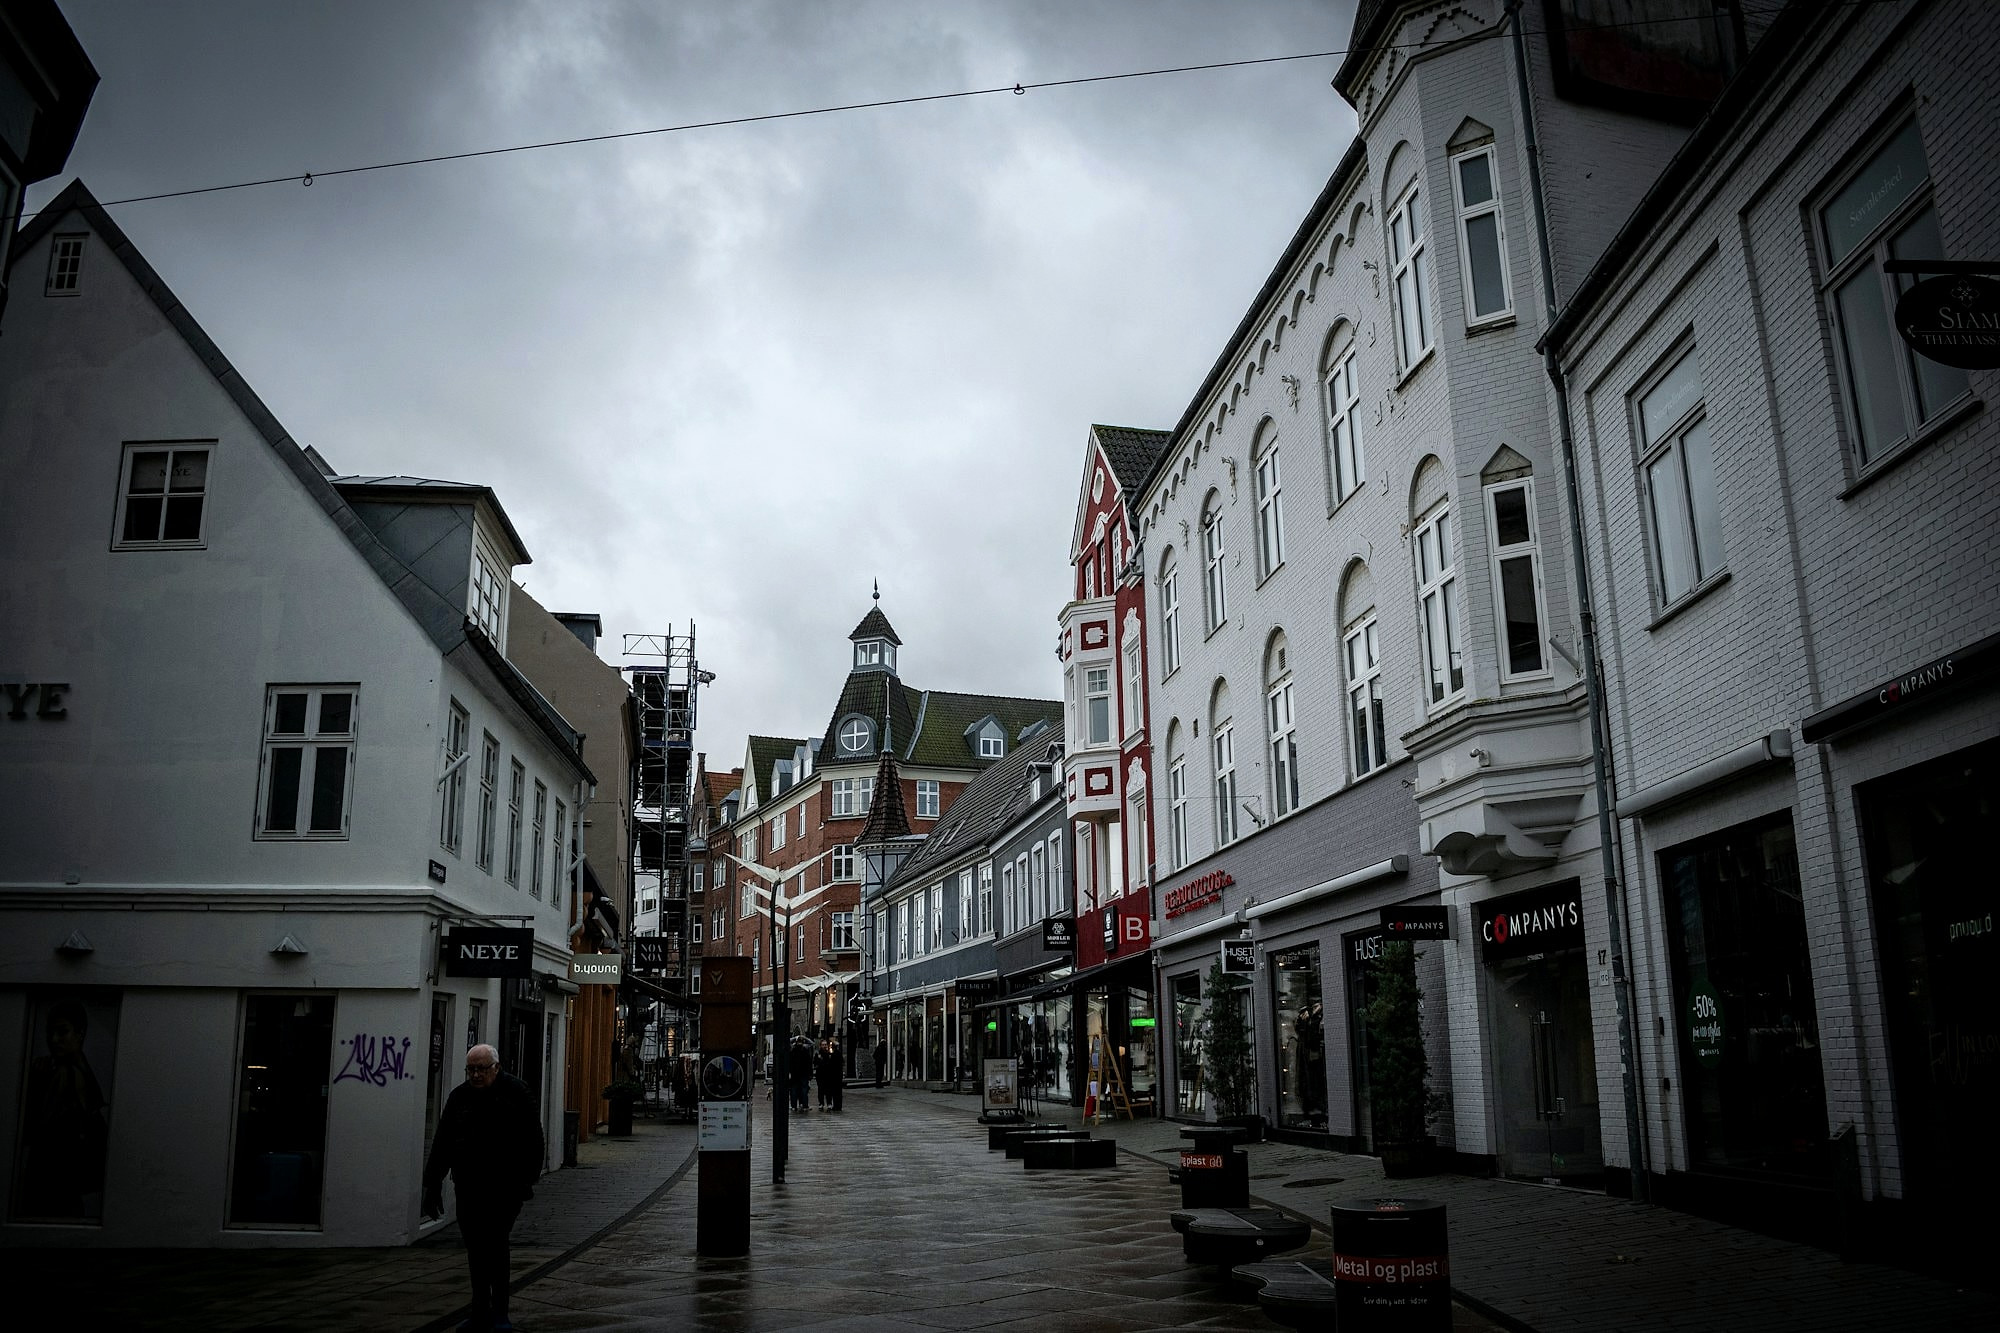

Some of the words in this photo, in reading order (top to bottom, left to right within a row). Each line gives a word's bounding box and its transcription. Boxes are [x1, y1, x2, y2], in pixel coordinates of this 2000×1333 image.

[1939, 306, 2000, 329] SIAM
[1921, 334, 1957, 345] THAI
[160, 468, 191, 477] NYE
[1880, 660, 1954, 704] COMPANYS
[0, 683, 69, 721] YE
[1125, 917, 1144, 941] B
[1388, 920, 1444, 933] COMPANYS
[1483, 901, 1578, 944] COMPANYS
[459, 944, 518, 960] NEYE
[640, 943, 662, 953] NOA
[1225, 947, 1254, 957] HUSET
[640, 952, 662, 962] NOA
[1597, 950, 1607, 965] 17
[574, 963, 618, 975] b.young
[1692, 995, 1717, 1018] -50%
[1187, 1156, 1206, 1168] plast
[1336, 1256, 1370, 1277] Metal
[1375, 1264, 1397, 1283] og
[1400, 1260, 1438, 1283] plast
